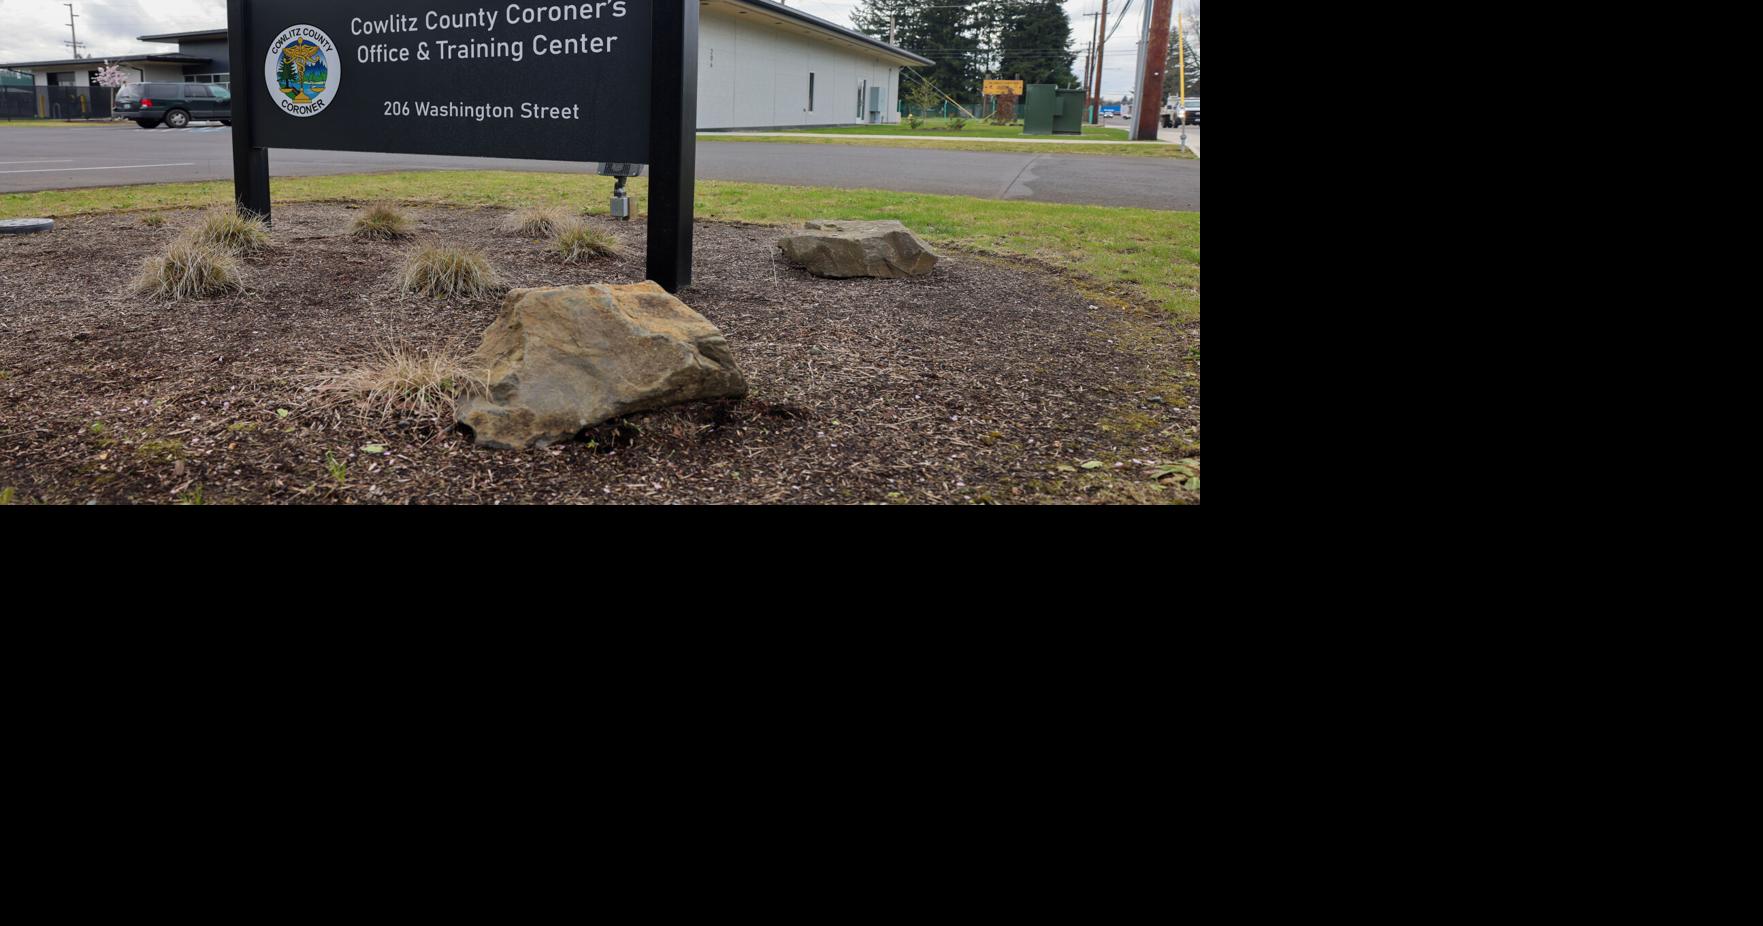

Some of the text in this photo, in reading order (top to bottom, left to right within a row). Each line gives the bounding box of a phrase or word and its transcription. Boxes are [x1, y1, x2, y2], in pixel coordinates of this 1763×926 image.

[350, 13, 419, 36] Cowlitz
[425, 7, 499, 32] County
[271, 27, 334, 55] COWLITZ COUNTY
[357, 33, 618, 64] Office & Training Center
[281, 98, 326, 115] CORONER
[383, 100, 580, 121] 206 Washington Street
